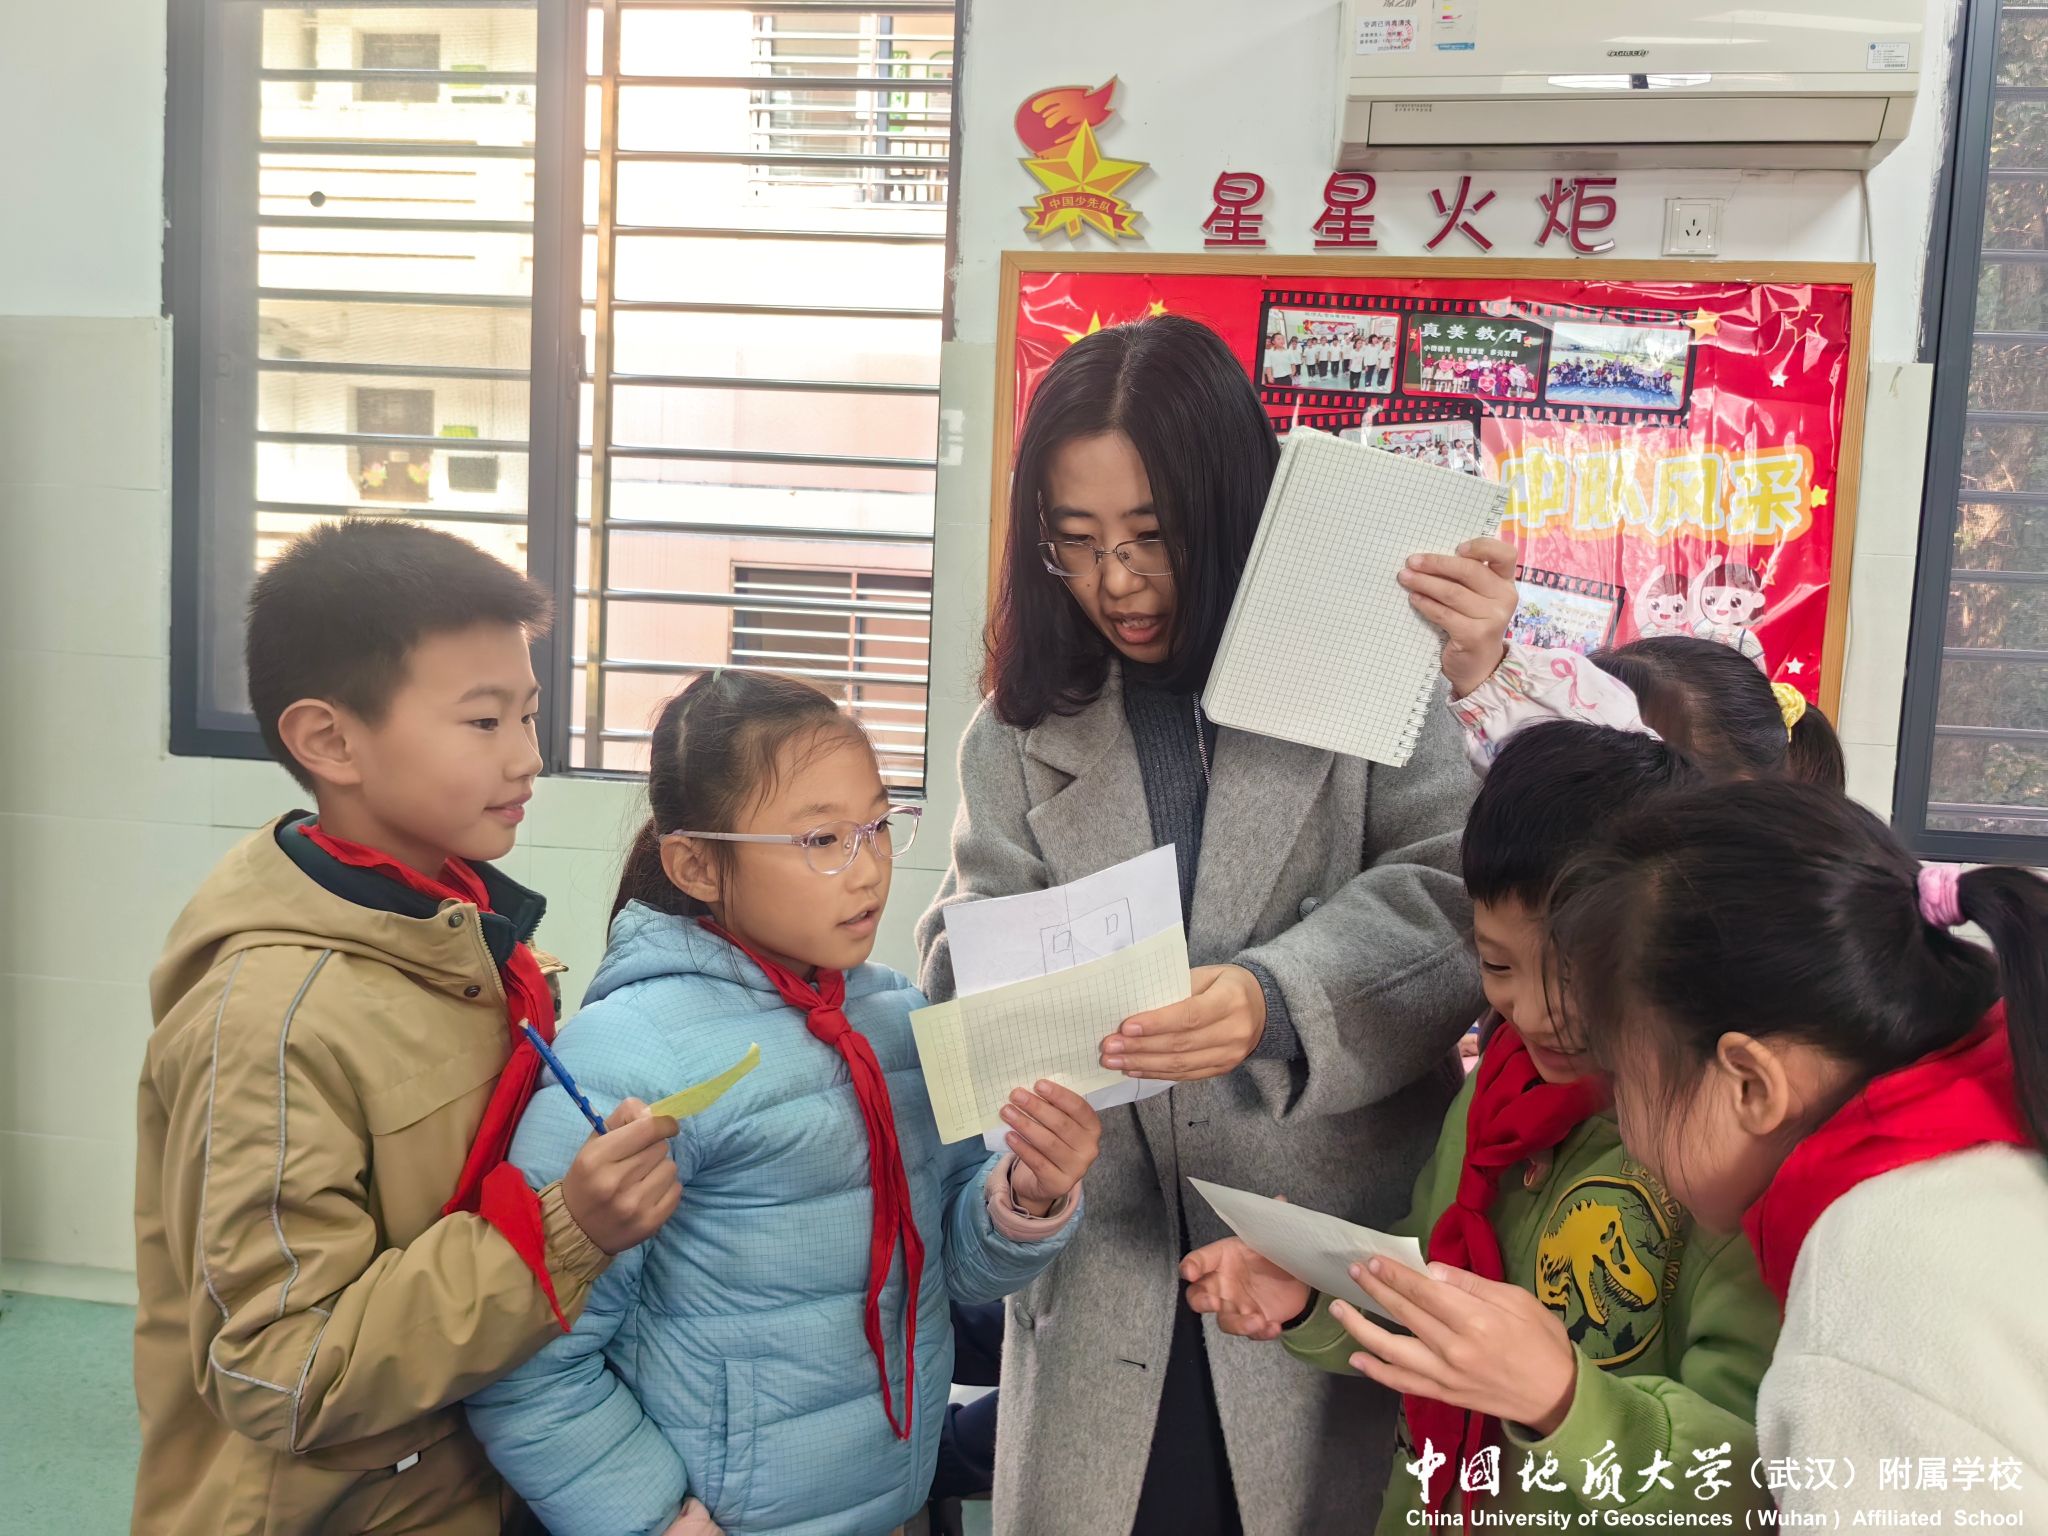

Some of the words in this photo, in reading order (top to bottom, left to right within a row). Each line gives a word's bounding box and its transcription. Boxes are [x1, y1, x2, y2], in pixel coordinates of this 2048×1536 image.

[1049, 196, 1110, 213] 中国少先队
[1201, 171, 1617, 254] 星星火炬
[1421, 322, 1527, 343] 真美教育
[1501, 447, 1804, 536] 中队风采
